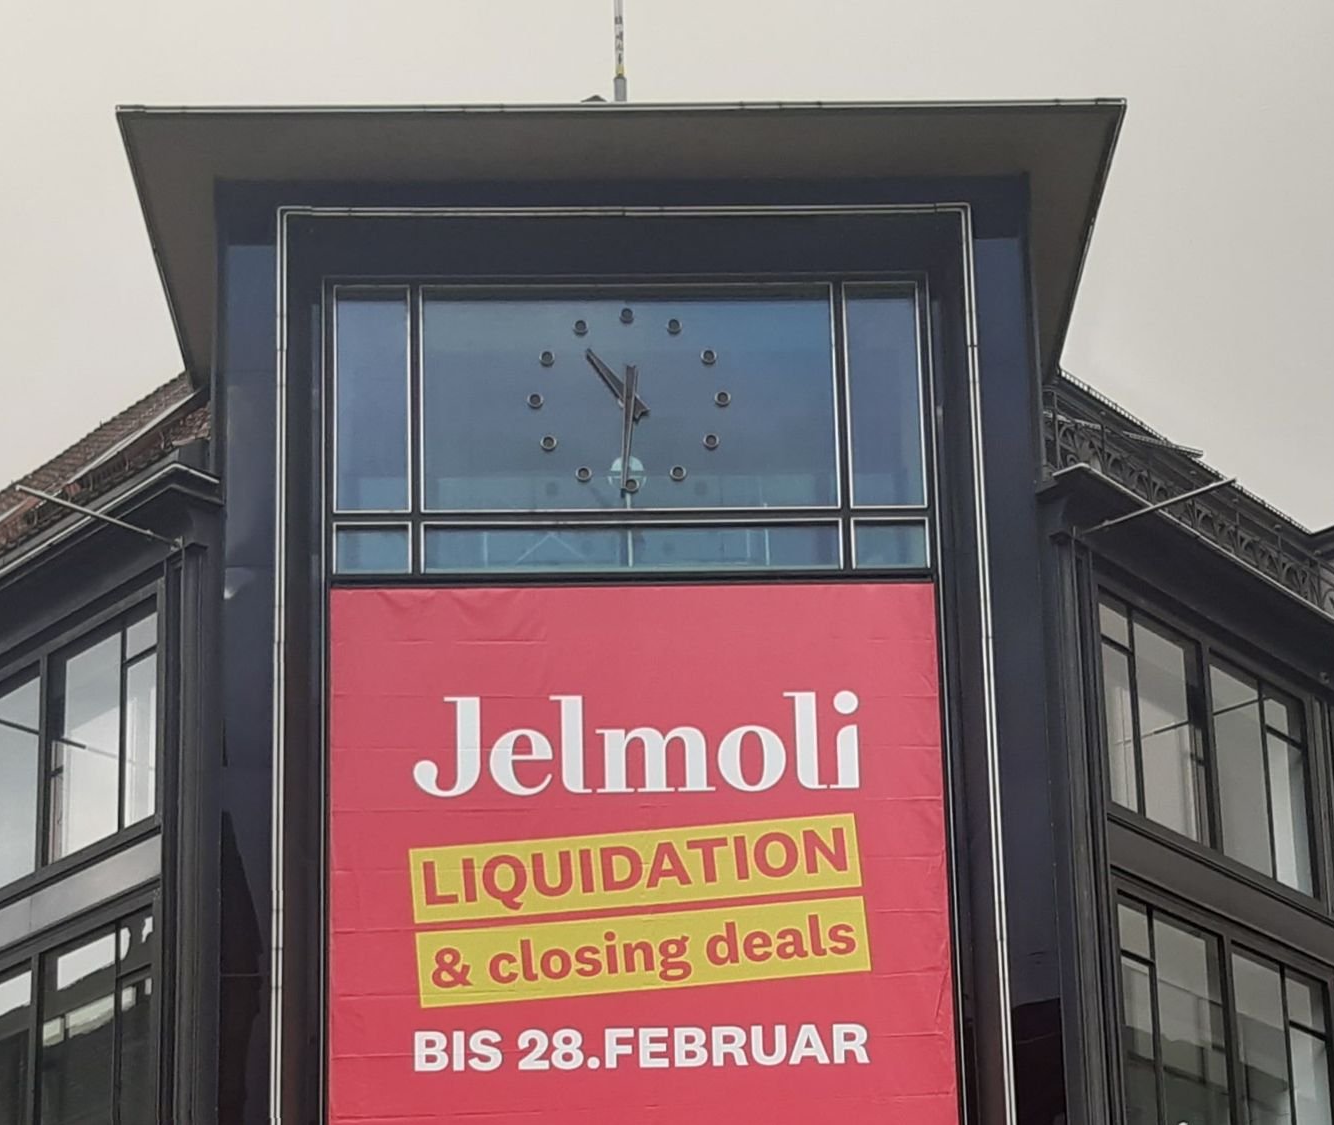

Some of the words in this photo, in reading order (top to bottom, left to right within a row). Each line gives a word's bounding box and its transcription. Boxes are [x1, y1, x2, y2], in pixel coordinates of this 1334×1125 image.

[413, 690, 861, 797] Jelmoli
[422, 827, 849, 911] LIQUIDATION
[431, 946, 473, 988] &
[488, 931, 693, 982] closing
[705, 913, 857, 965] deals
[413, 1030, 503, 1072] BIS
[516, 1022, 871, 1070] 28.FEBRUAR
